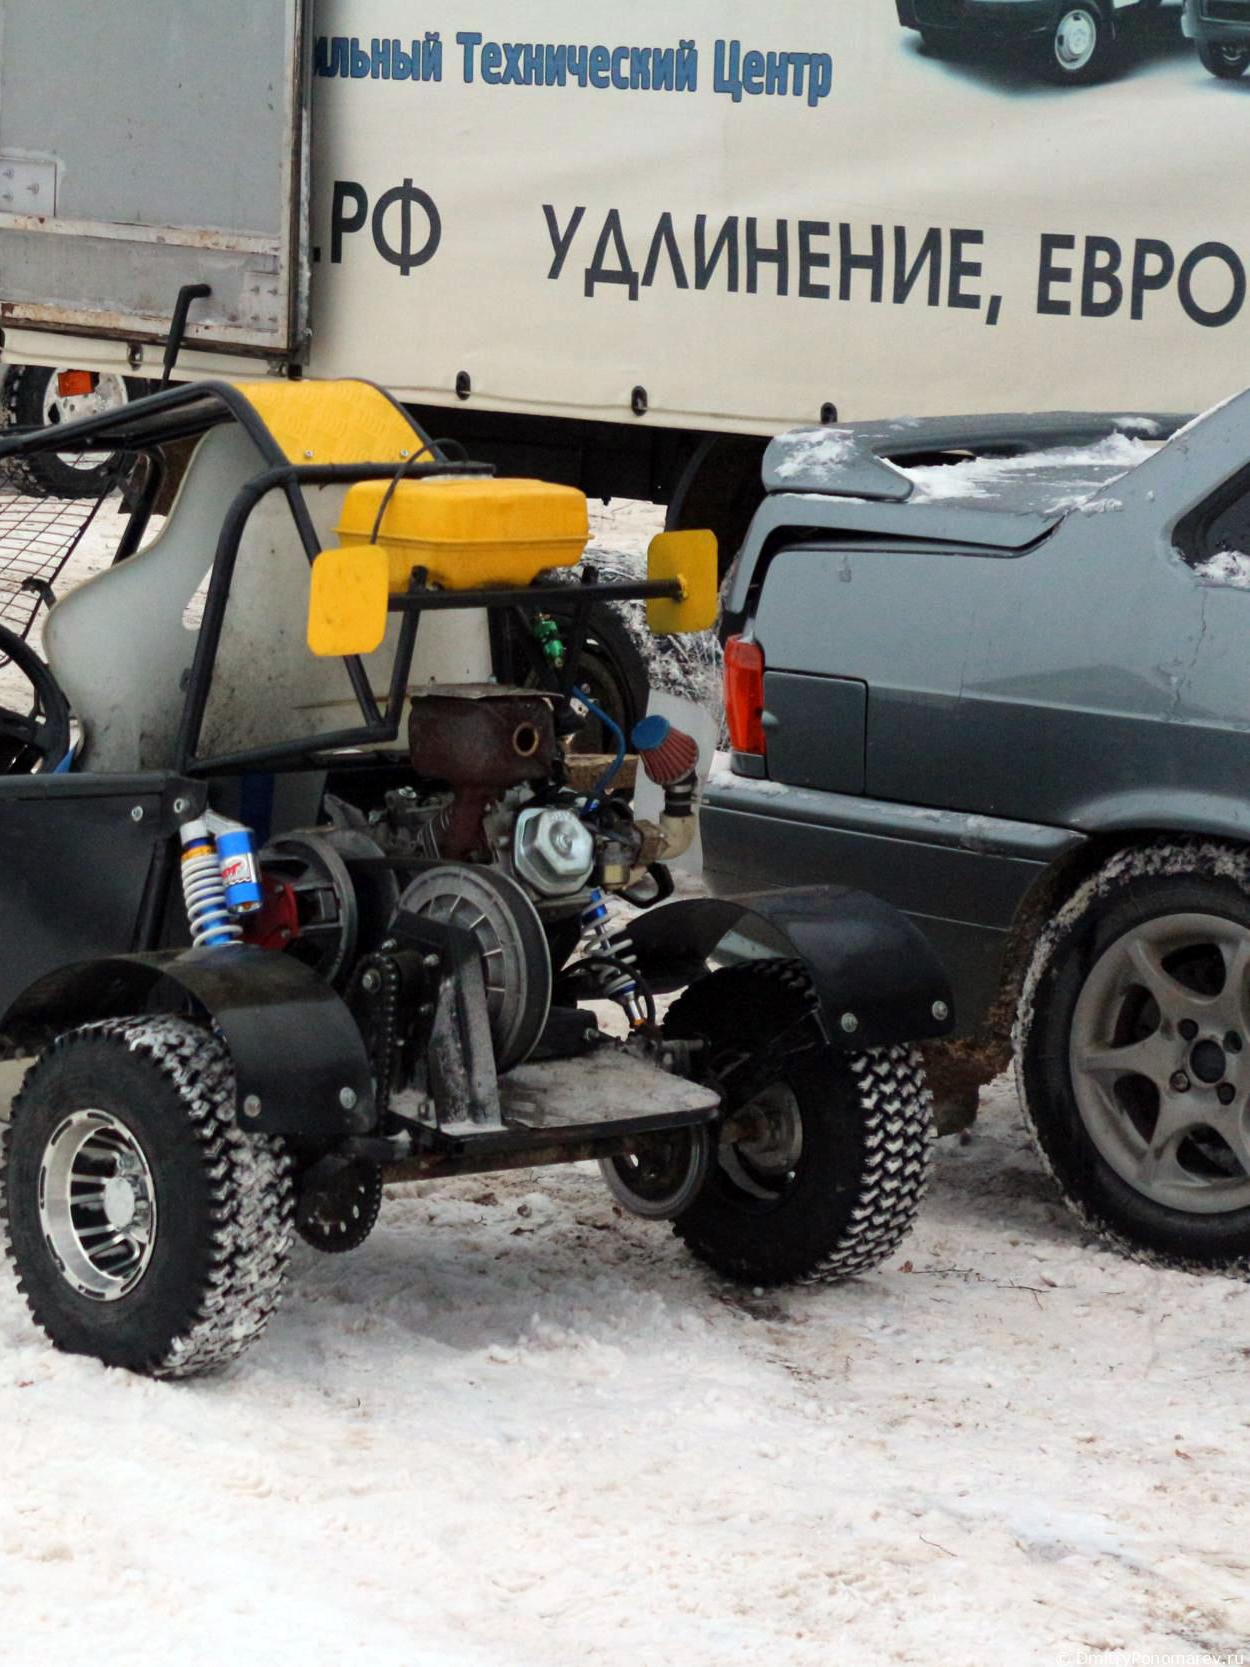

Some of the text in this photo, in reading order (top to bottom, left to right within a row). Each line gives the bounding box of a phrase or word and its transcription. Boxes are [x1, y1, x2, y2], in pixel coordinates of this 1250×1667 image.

[456, 31, 698, 92] Технический
[713, 39, 833, 107] Центр
[542, 204, 1002, 325] УДЛИНЕНИЕ,
[1036, 233, 1247, 328] ЕВРО
